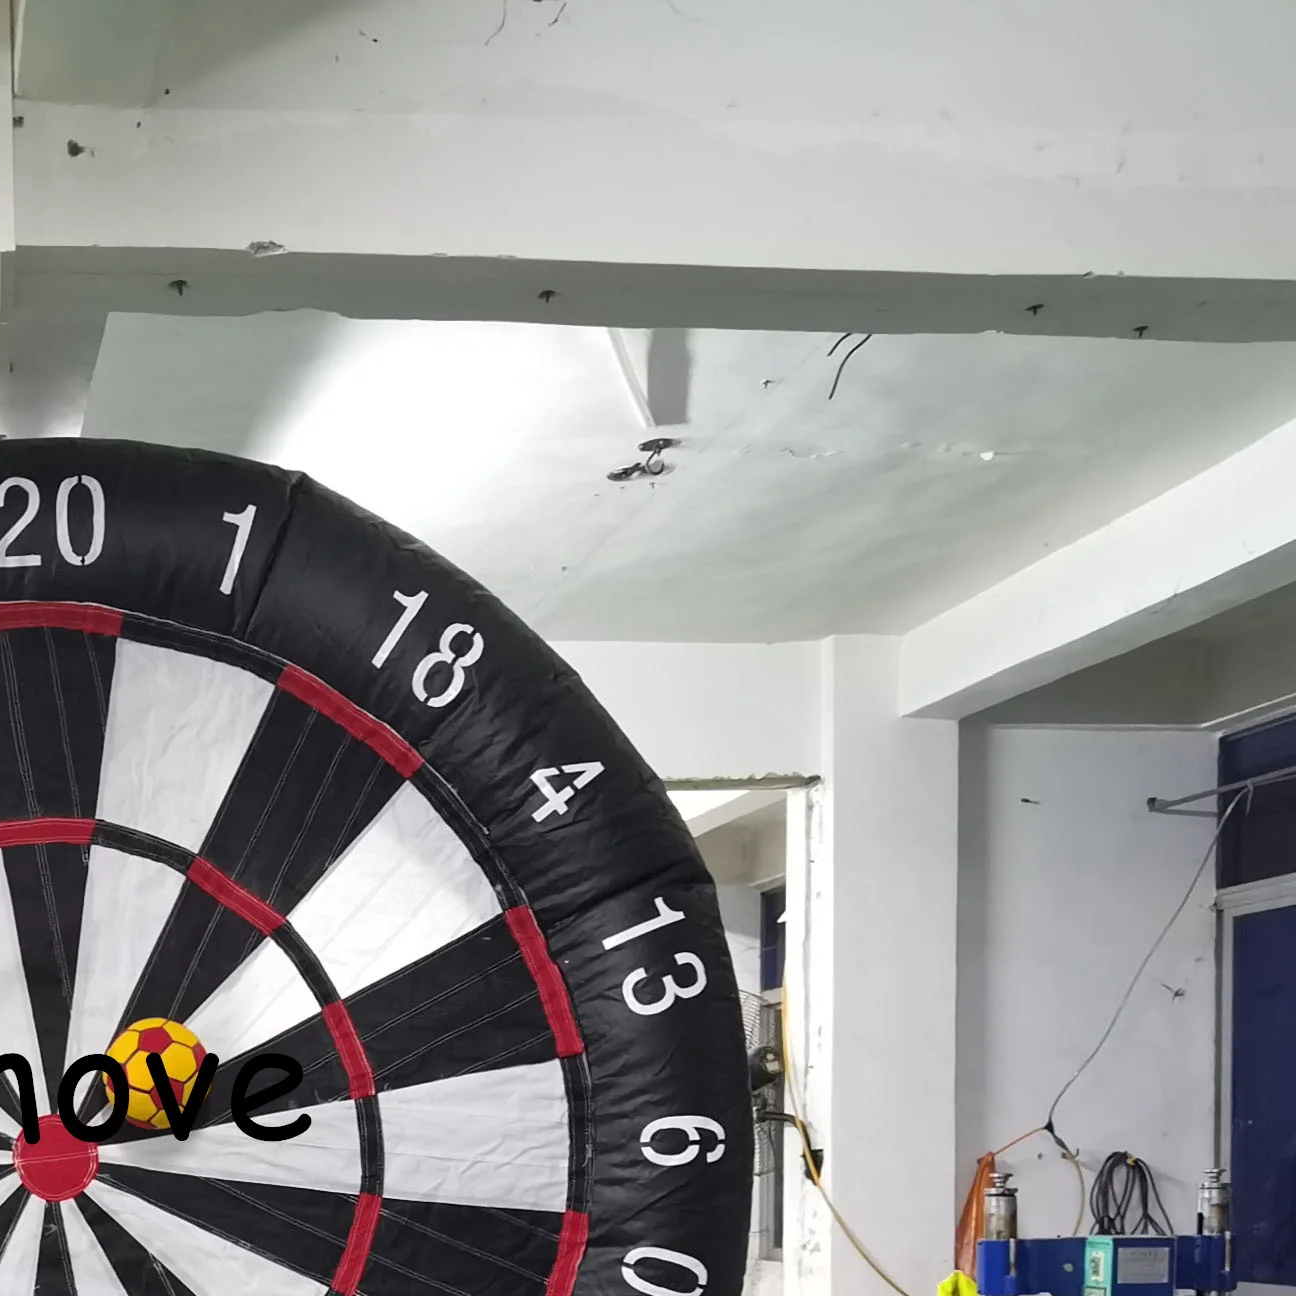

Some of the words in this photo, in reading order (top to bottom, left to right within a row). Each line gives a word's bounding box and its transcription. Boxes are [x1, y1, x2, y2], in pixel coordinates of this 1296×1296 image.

[219, 504, 257, 595] 1
[372, 588, 485, 708] 18
[529, 761, 605, 823] 4
[601, 896, 707, 1016] 13
[639, 1115, 725, 1167] 6
